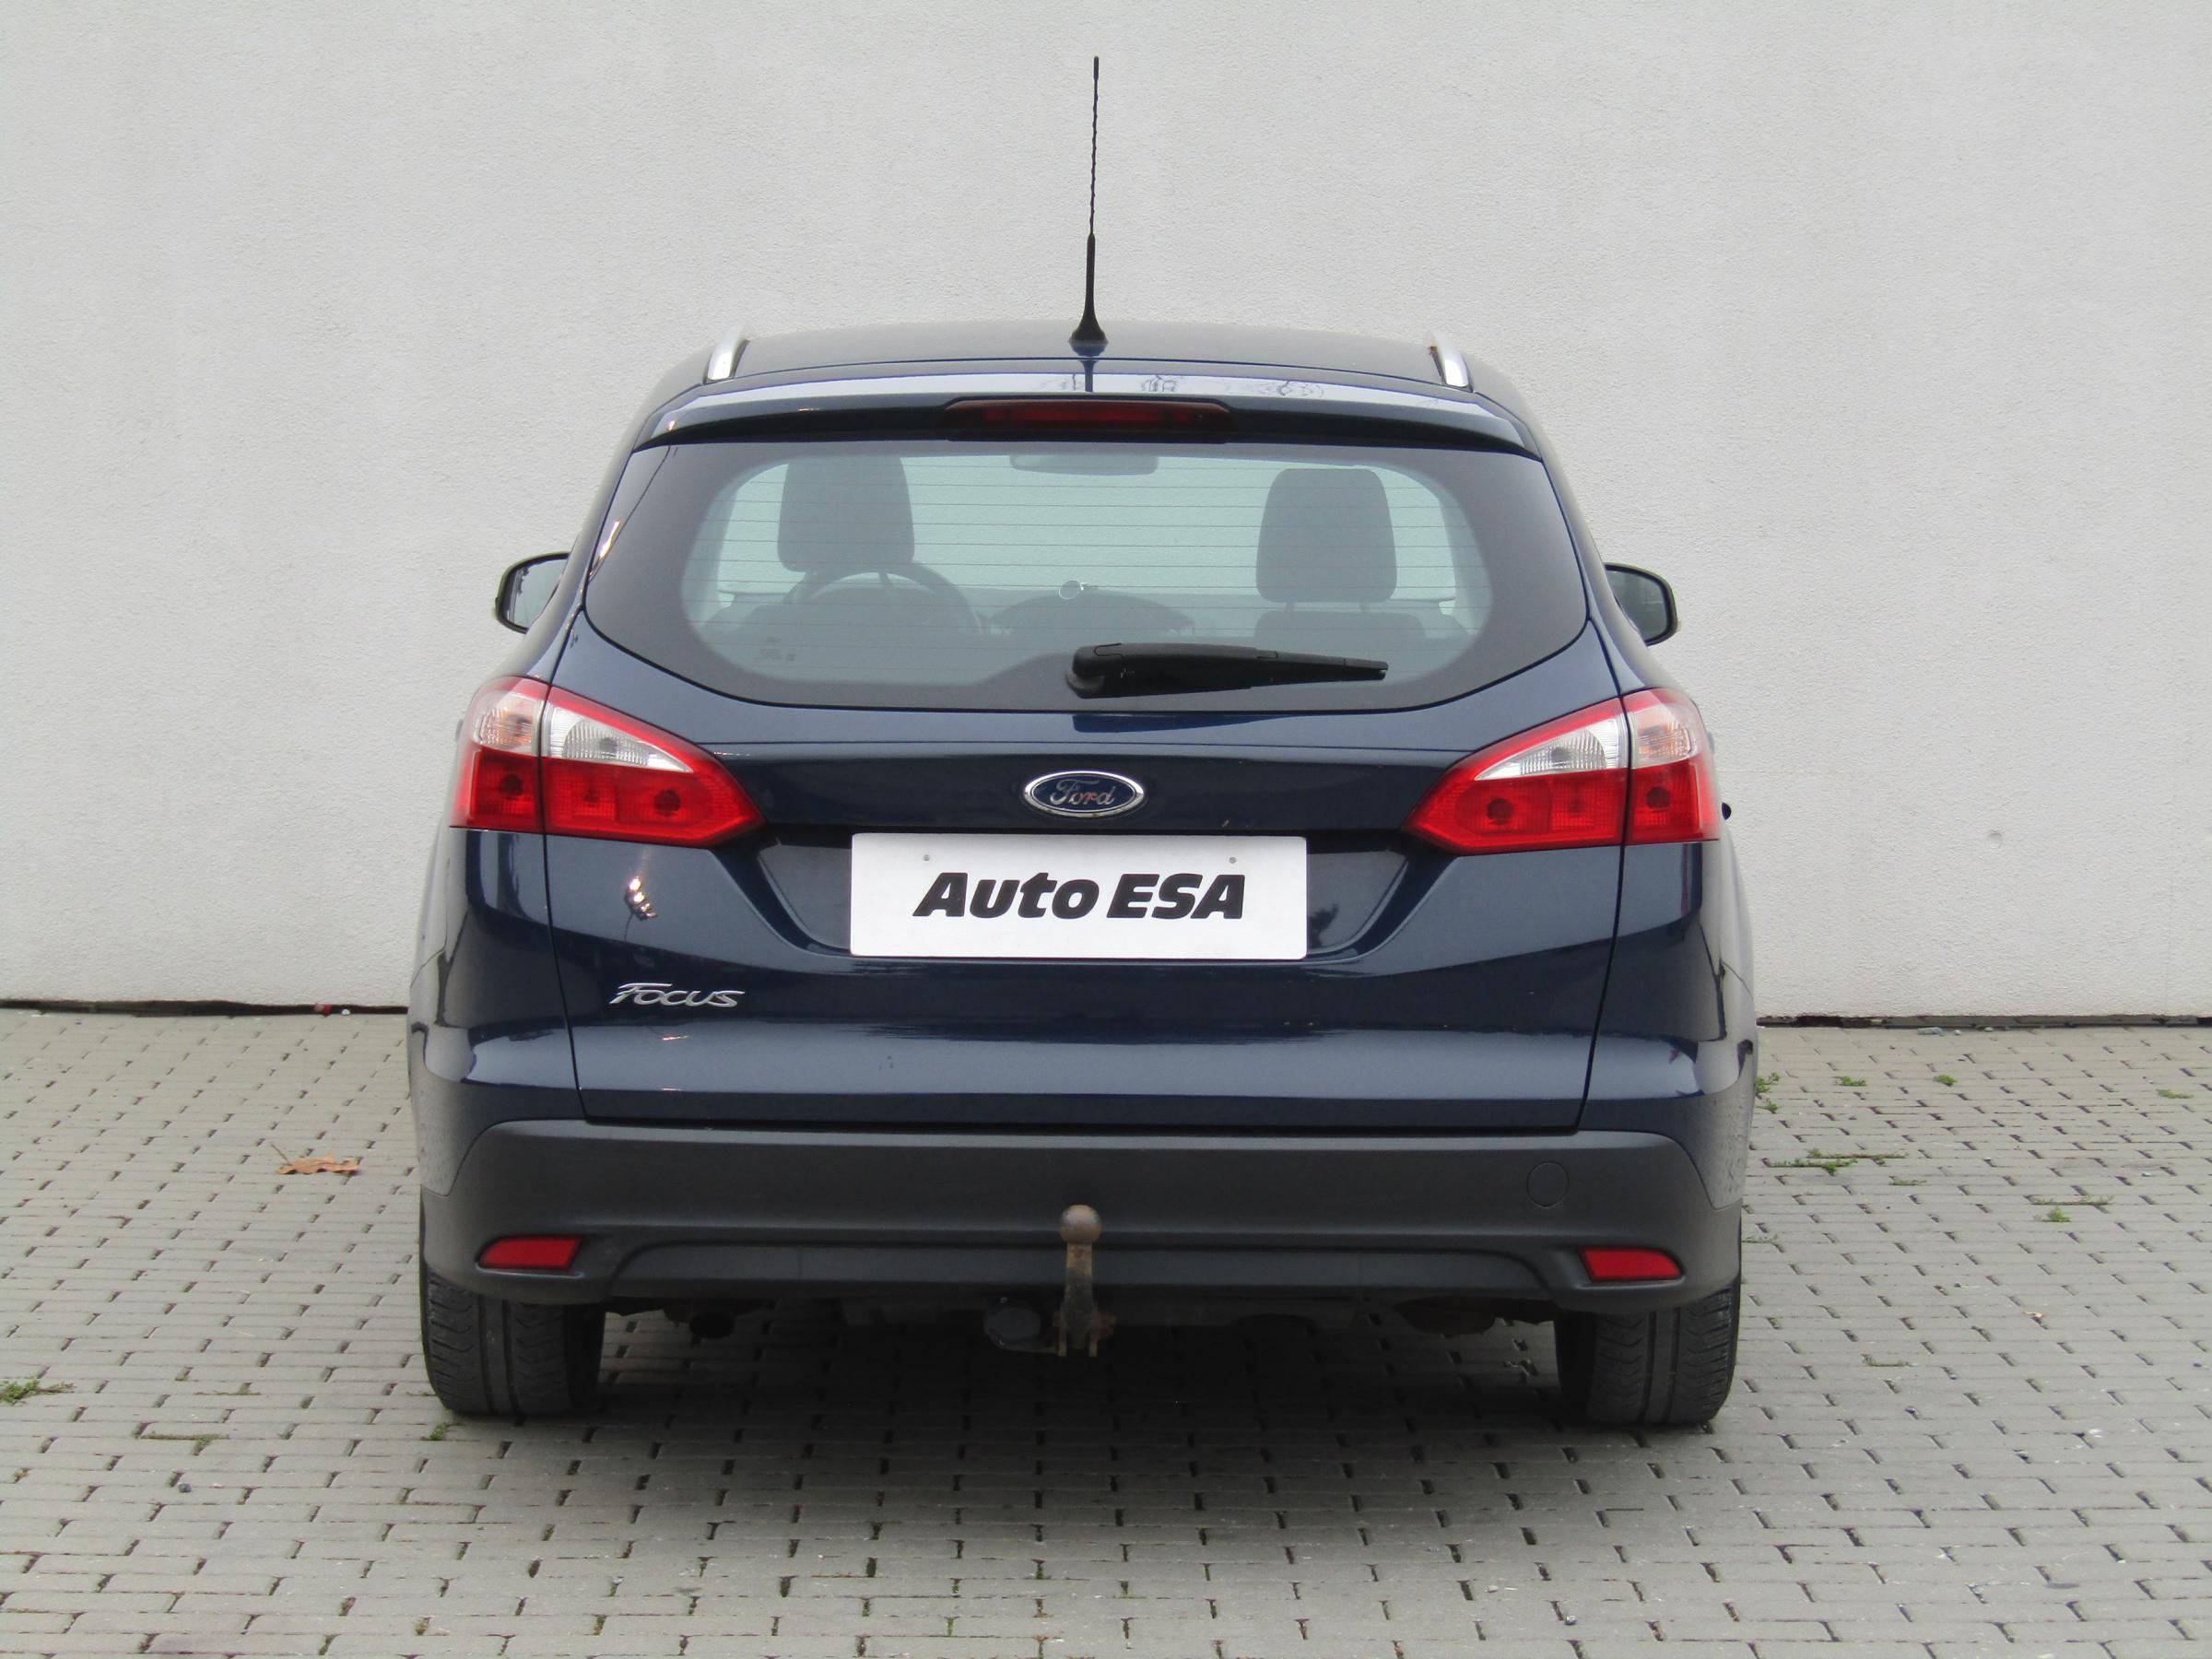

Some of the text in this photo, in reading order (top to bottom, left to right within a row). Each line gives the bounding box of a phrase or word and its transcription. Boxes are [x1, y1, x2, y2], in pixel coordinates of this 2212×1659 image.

[1049, 779, 1116, 806] Ford
[912, 872, 1246, 920] Auto ESA
